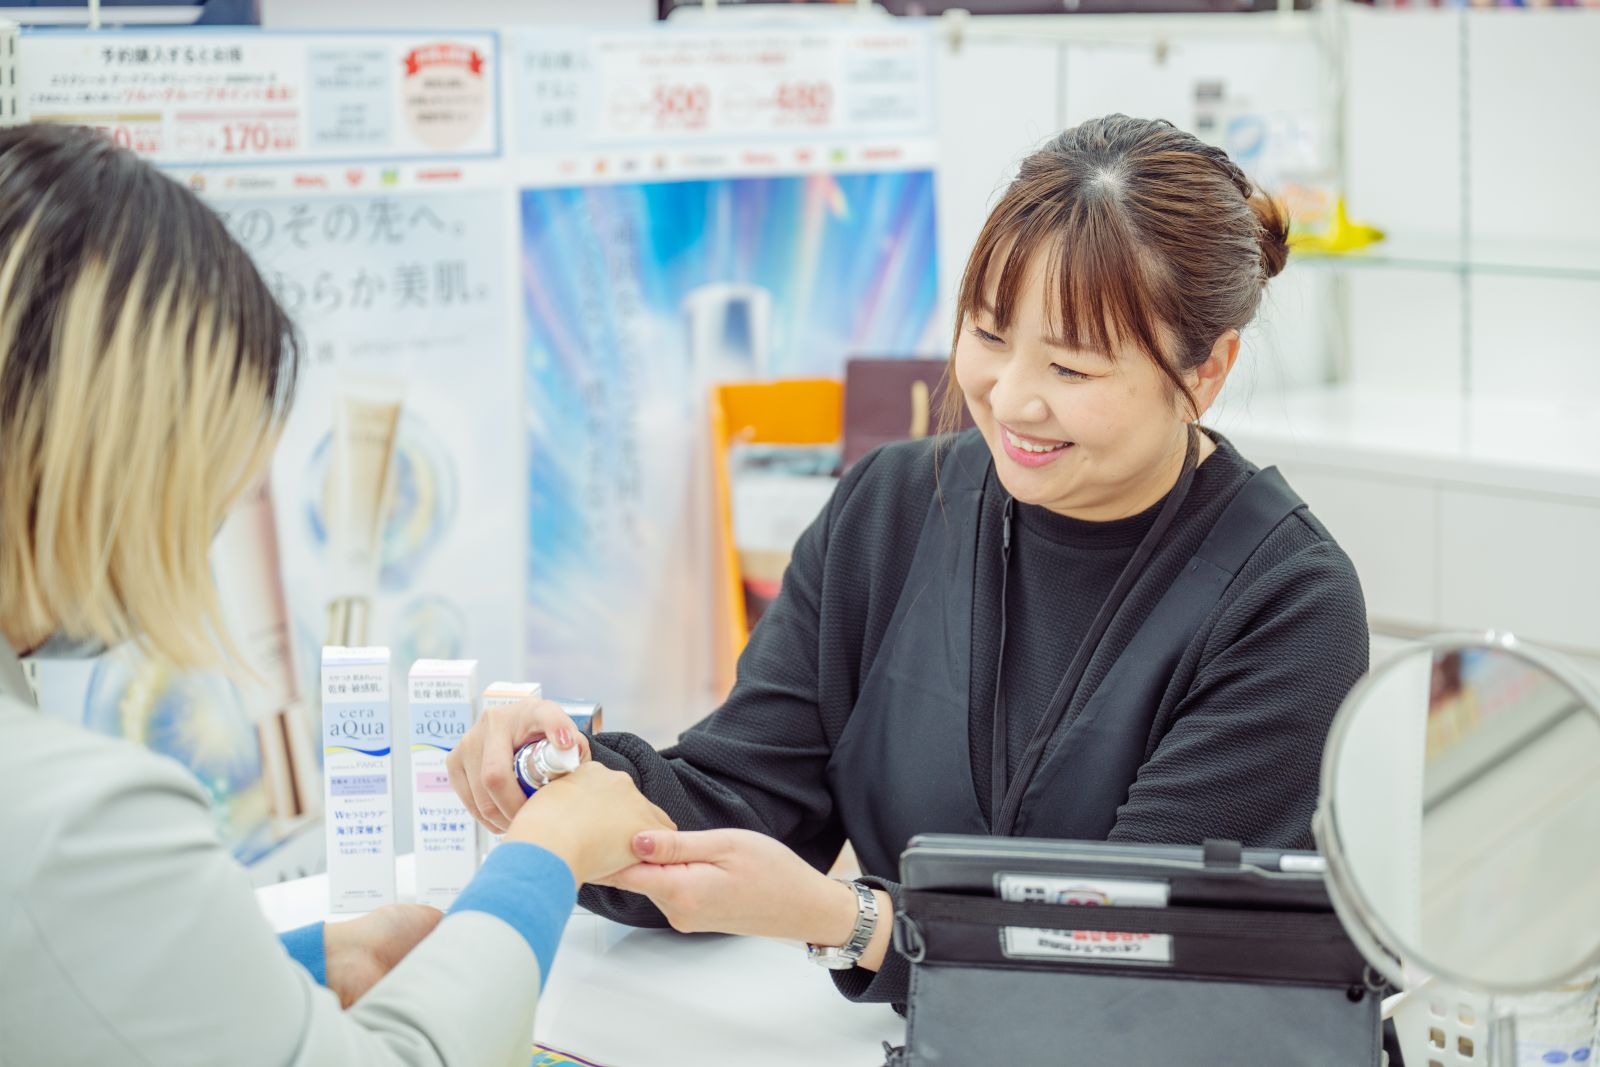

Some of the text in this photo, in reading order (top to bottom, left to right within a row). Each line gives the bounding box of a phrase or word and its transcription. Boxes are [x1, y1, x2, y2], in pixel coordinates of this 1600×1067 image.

[221, 122, 270, 154] 170
[339, 708, 375, 719] cera
[424, 708, 457, 719] cera
[330, 719, 385, 741] aQua
[415, 718, 466, 740] aQua
